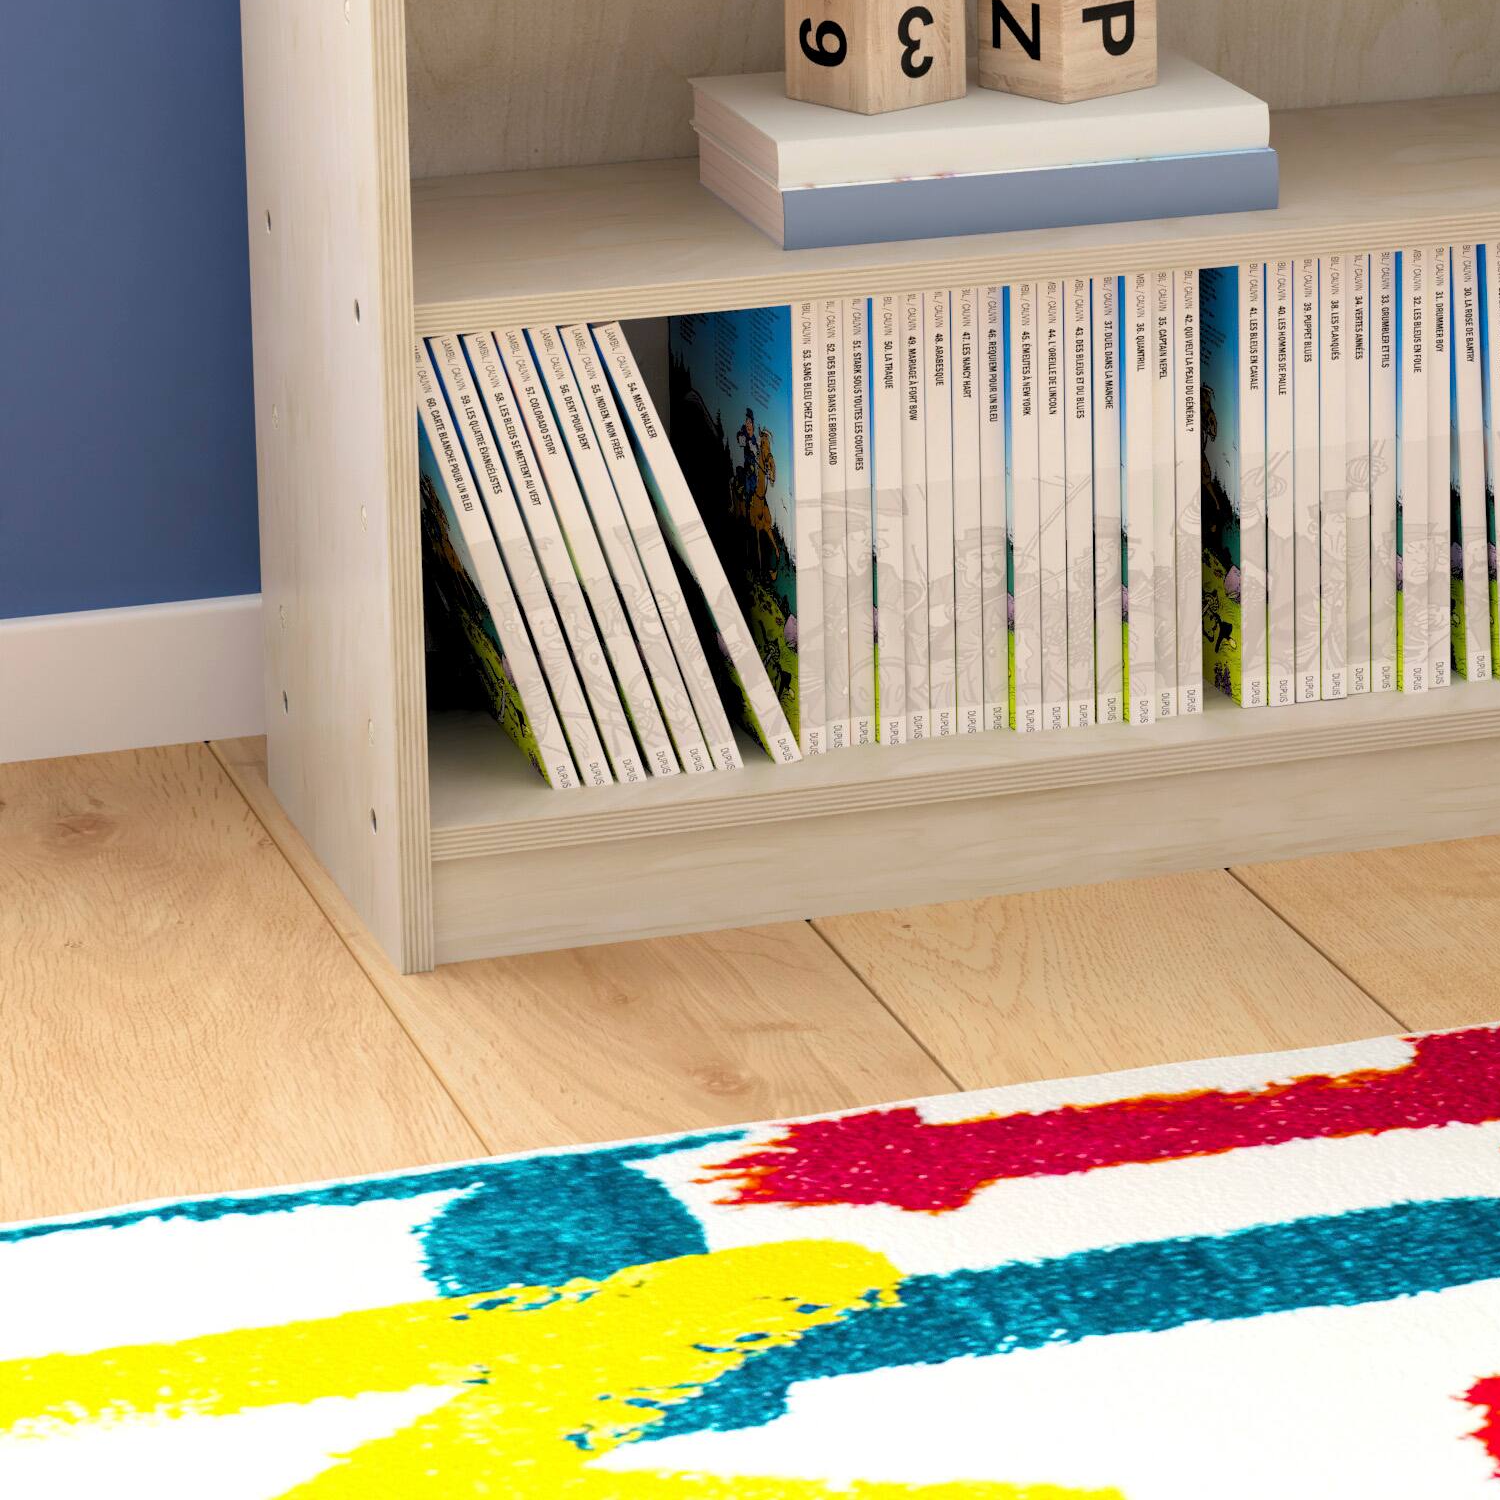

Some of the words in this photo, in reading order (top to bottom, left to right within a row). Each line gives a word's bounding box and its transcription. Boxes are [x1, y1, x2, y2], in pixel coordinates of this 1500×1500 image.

[1082, 0, 1135, 57] P
[1303, 314, 1312, 340] PUPPET
[1330, 311, 1340, 325] LES
[1354, 307, 1364, 333] VERTES
[1435, 302, 1444, 338] DRUMMER
[604, 327, 620, 352] LAMBIL
[962, 342, 971, 356] LES
[1158, 328, 1168, 357] CAPTAIN
[1435, 338, 1444, 353] BOY
[884, 353, 893, 362] LA
[1135, 335, 1145, 372] QUANTRILL
[1303, 341, 1313, 363] BLUES
[616, 355, 633, 379] CAUVIN
[802, 362, 812, 382] SANG
[883, 362, 894, 389] TRAQUE
[934, 345, 945, 387] ARABESQUE
[962, 356, 972, 380] NANCY
[1159, 358, 1168, 380] NEPEL
[803, 382, 813, 401] BLEU
[962, 380, 972, 398] HART
[464, 406, 477, 421] LES
[632, 393, 647, 412] MISS
[803, 401, 813, 420] CHEZ
[468, 420, 487, 447] QUATRE
[529, 397, 549, 434] COLORADO
[542, 434, 558, 455] STORY
[639, 411, 658, 439] WALKER
[803, 420, 813, 433] LES
[804, 433, 814, 457] BLEUS
